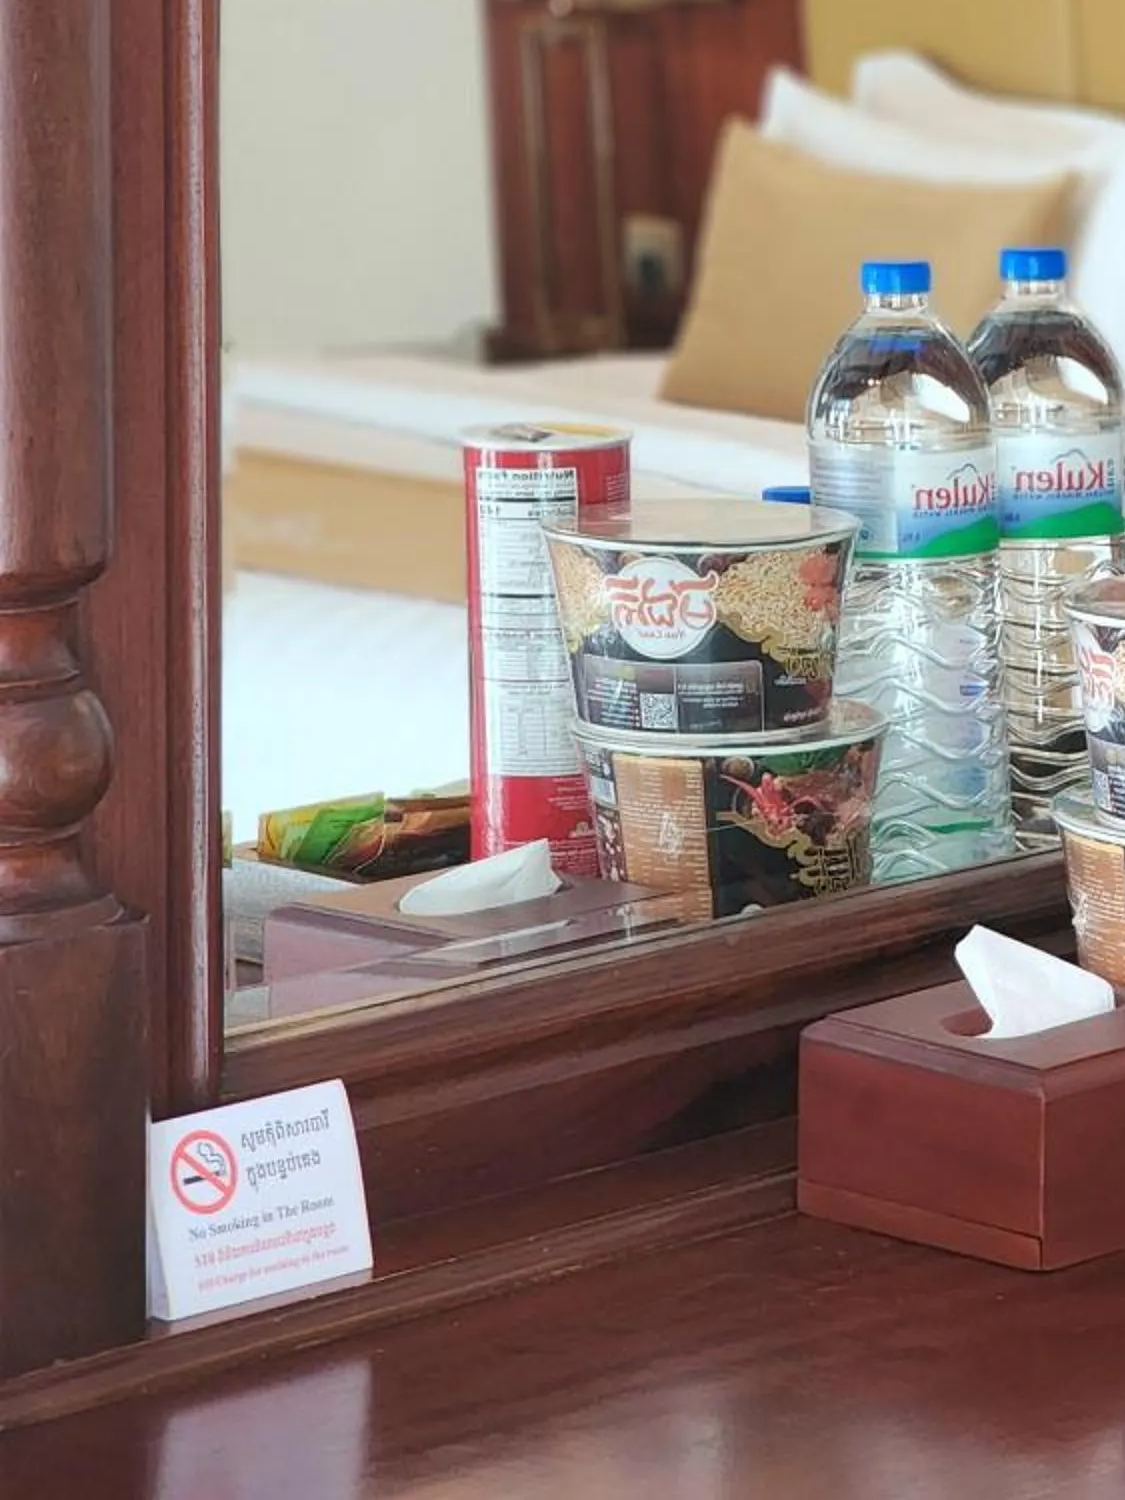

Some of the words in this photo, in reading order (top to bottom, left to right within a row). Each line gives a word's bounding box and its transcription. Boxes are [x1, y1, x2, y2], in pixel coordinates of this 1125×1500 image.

[188, 1226, 207, 1242] No
[208, 1213, 260, 1237] Smoking
[262, 1208, 274, 1223] in
[276, 1203, 298, 1221] The
[301, 1195, 334, 1214] Room
